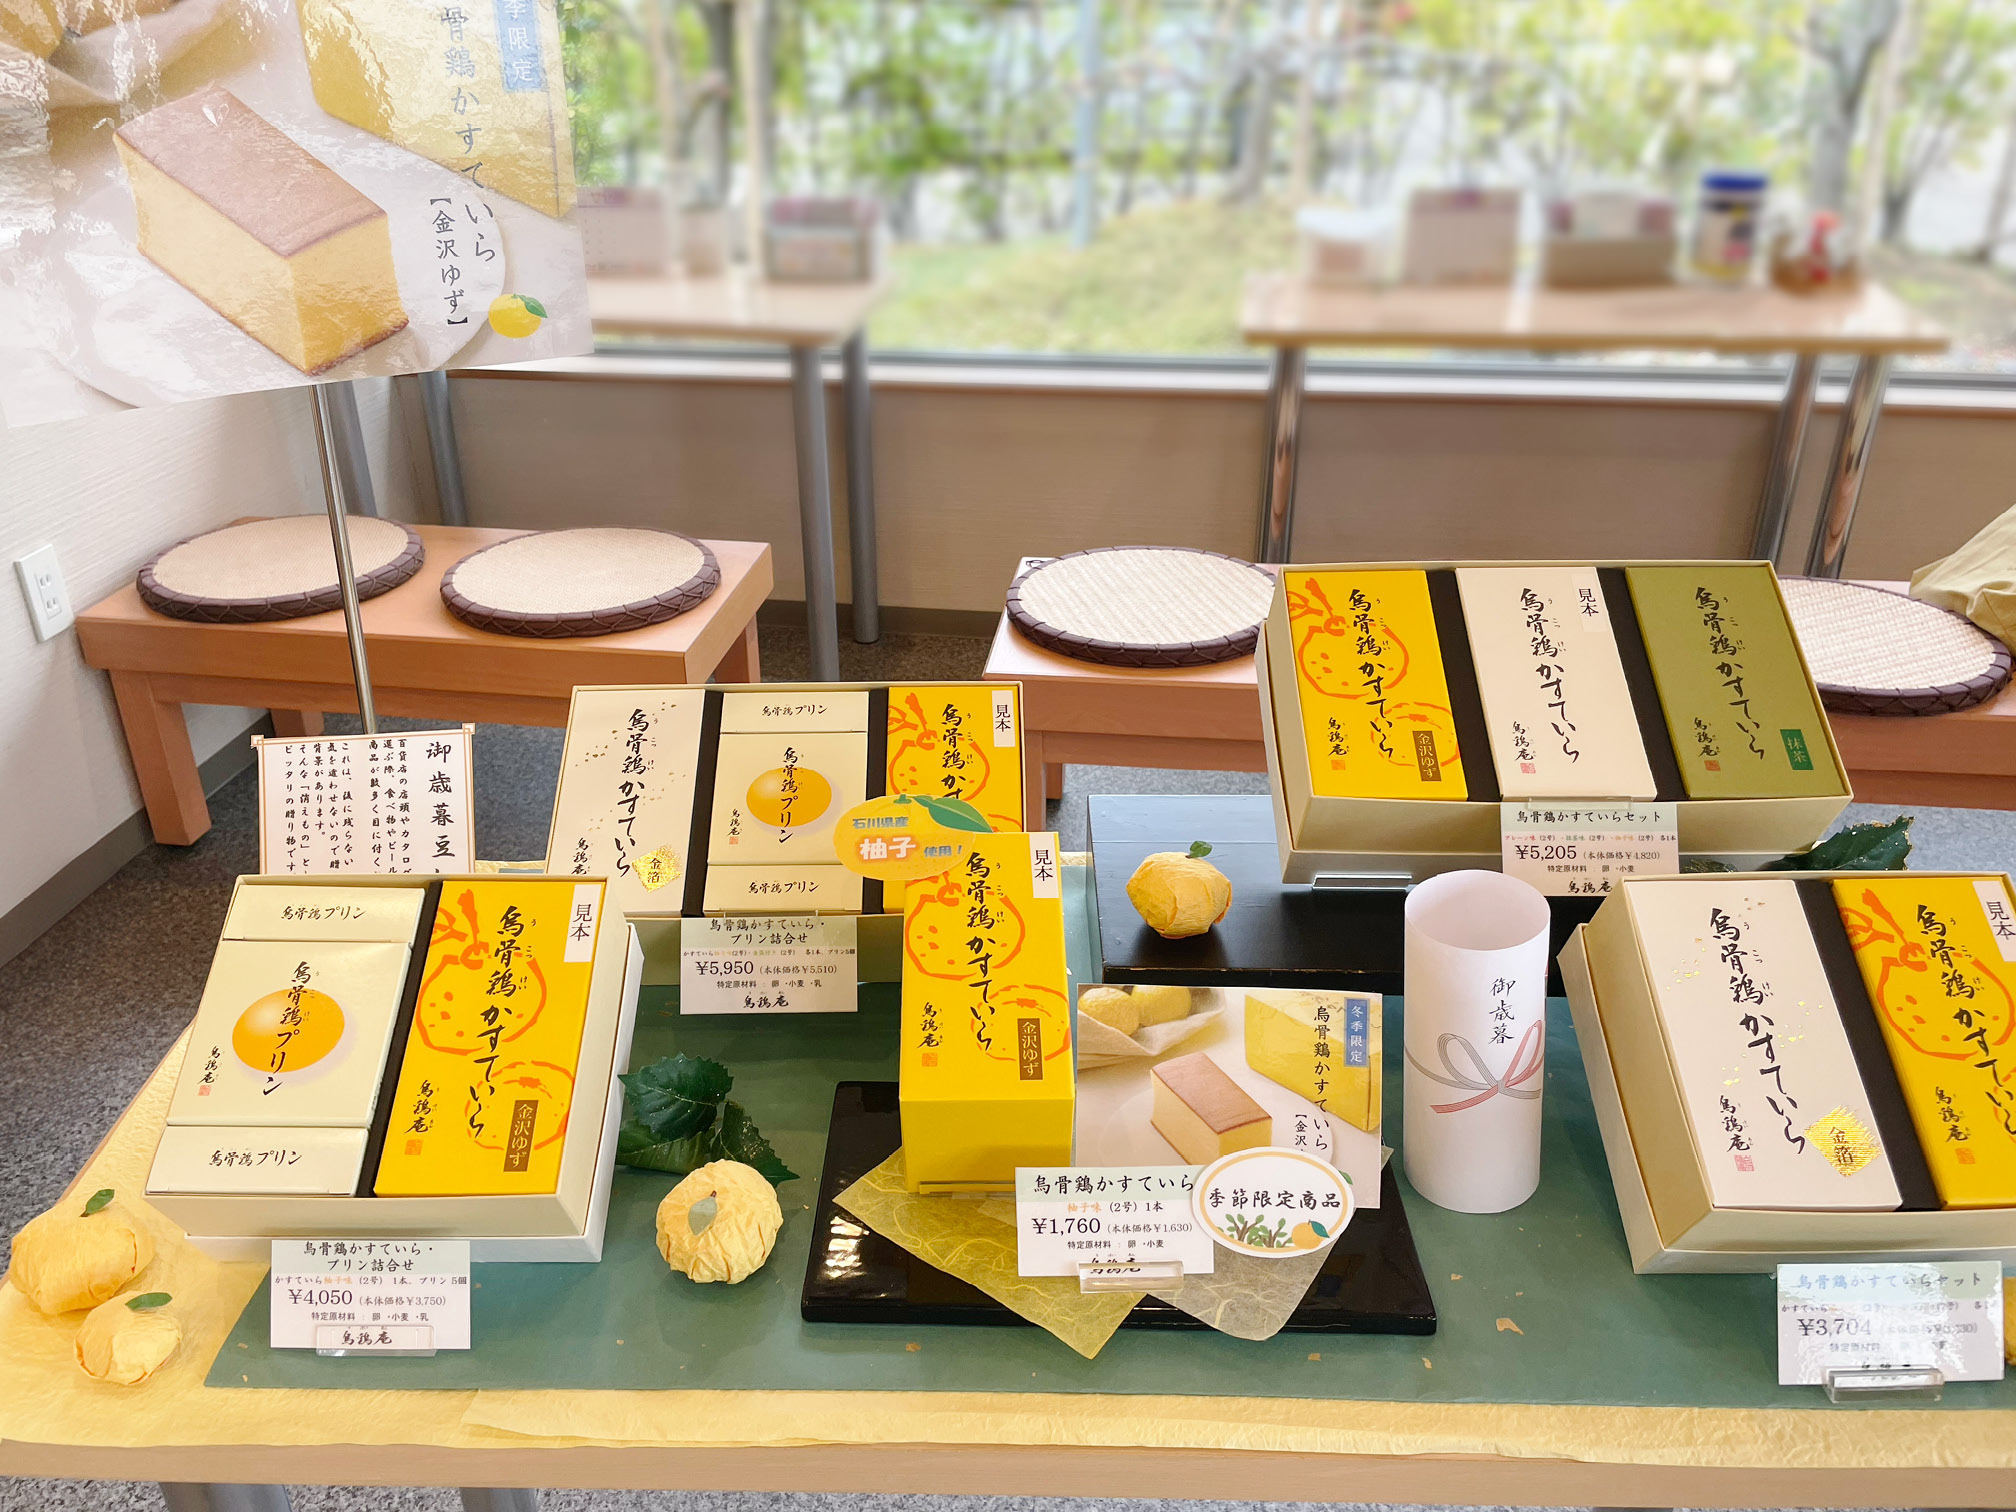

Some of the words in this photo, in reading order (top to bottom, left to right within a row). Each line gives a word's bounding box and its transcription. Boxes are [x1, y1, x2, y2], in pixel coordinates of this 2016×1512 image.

[441, 7, 496, 262] 骨鶏かすていら
[430, 198, 468, 325] 【金沢ゆず】
[1578, 588, 1599, 617] 見本
[995, 704, 1011, 732] 見本
[1417, 733, 1437, 779] 金沢ゆず
[1786, 737, 1808, 764] 抹茶
[285, 744, 297, 874] ピッタリの贈り物です
[369, 739, 382, 873] 商品が数多く目に付く
[426, 741, 455, 873] 御歳暮豆
[1517, 810, 1662, 823] 烏骨鶏かすていらセット
[852, 816, 909, 829] 石川県産
[859, 836, 917, 860] 柚子
[1515, 845, 1577, 861] ¥5,205
[647, 857, 662, 884] 金箔
[1034, 849, 1054, 881] 見本
[1547, 864, 1588, 873] 特定原材料
[569, 903, 593, 941] 見本
[1987, 901, 2016, 941] 見本
[731, 932, 808, 945] プリン詰合せ
[695, 960, 755, 977] ¥5,950
[759, 965, 838, 976] (本体価格¥5,510)
[717, 979, 757, 989] 特定原材料
[771, 979, 780, 988] 卵
[1488, 976, 1517, 1045] 御歳暮
[1350, 1004, 1364, 1064] 冬季限定
[1021, 1021, 1040, 1078] 金沢ゆず
[1314, 1005, 1331, 1151] 烏骨鶏かすていら
[508, 1103, 533, 1169] 金沢ゆず
[1295, 1114, 1308, 1151] 【金沢
[1829, 1126, 1855, 1165] 金箔
[1034, 1174, 1194, 1195] 烏骨鶏かすていら
[1067, 1201, 1102, 1213] 柚子味
[1208, 1187, 1342, 1210] 季節限定商品
[1031, 1217, 1101, 1236] ¥1,760
[1107, 1222, 1194, 1234] (本体価格¥1,630)
[1067, 1240, 1112, 1250] 特定原材料
[1127, 1240, 1137, 1249] 卵
[327, 1258, 415, 1272] プリン詰合せ
[288, 1289, 353, 1306] ¥4,050
[359, 1295, 447, 1306] (本体価格¥3,750)
[311, 1311, 356, 1321] 特定原材料
[372, 1312, 381, 1321] 卵
[1797, 1318, 1871, 1337] ¥3,704
